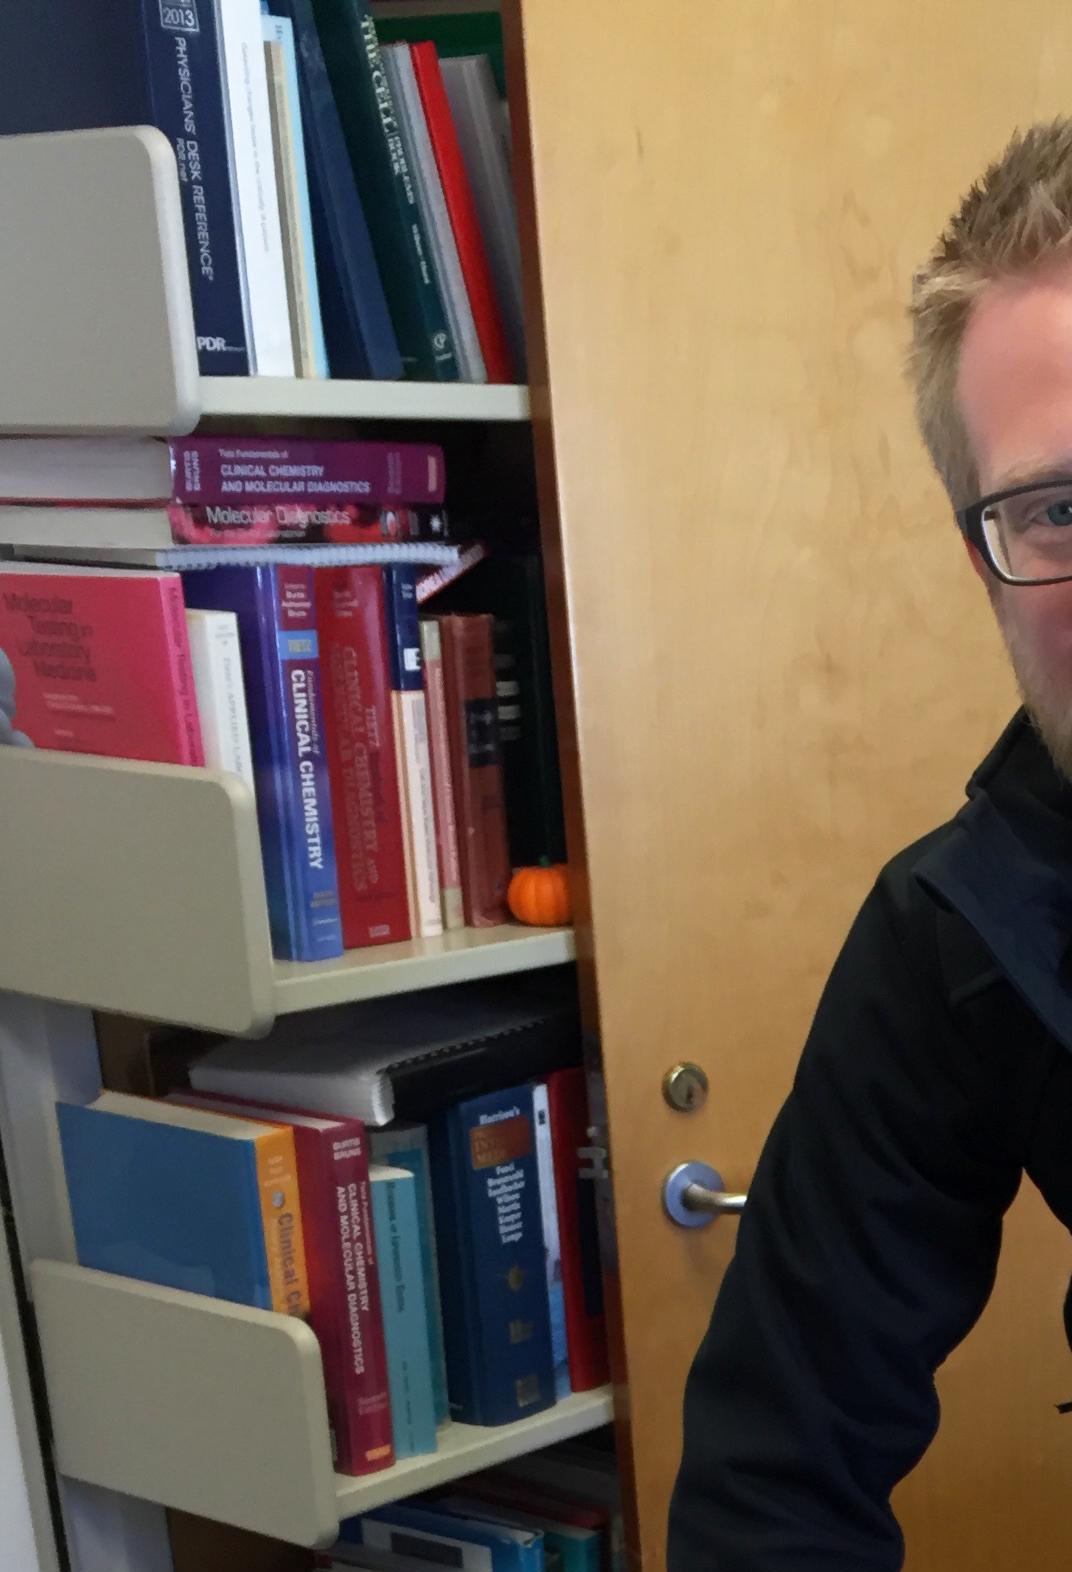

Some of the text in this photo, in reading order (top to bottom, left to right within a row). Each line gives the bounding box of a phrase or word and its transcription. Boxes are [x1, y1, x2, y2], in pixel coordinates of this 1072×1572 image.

[163, 8, 195, 27] 2013
[187, 140, 202, 181] DESK
[196, 336, 226, 351] PDR
[220, 464, 324, 478] CLINICAL CHEMISTRY
[221, 480, 371, 494] AND MOLECULAR DIAGNOSTICS
[205, 504, 351, 529] Molecular Diagnostics
[291, 669, 309, 757] CLINICAL
[299, 760, 324, 869] CHEMISTRY
[277, 1212, 296, 1285] Clinical
[347, 1183, 370, 1312] CLINICAL CHEMISTRY
[336, 1186, 366, 1375] AND MOLECULAR DIAGNOSTICS
